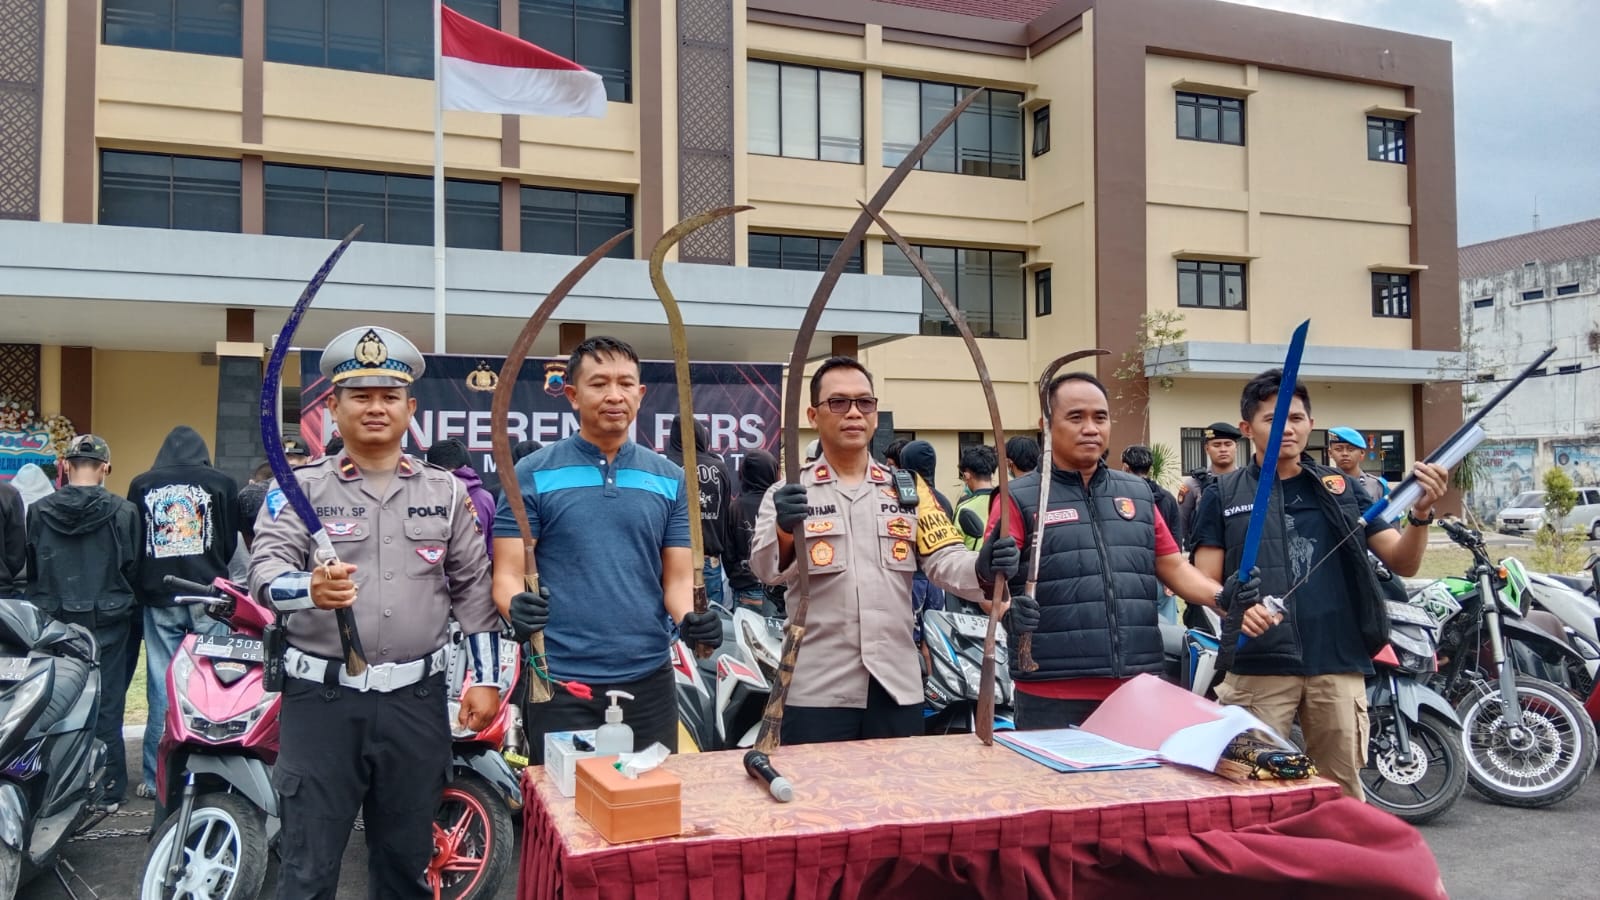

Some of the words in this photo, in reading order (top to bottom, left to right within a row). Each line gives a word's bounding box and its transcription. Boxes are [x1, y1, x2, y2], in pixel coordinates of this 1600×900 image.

[654, 413, 766, 450] PRS
[901, 488, 915, 497] T2
[408, 505, 447, 518] POLRI
[918, 513, 950, 533] WAKA
[196, 634, 214, 645] AA
[227, 638, 262, 650] 2503
